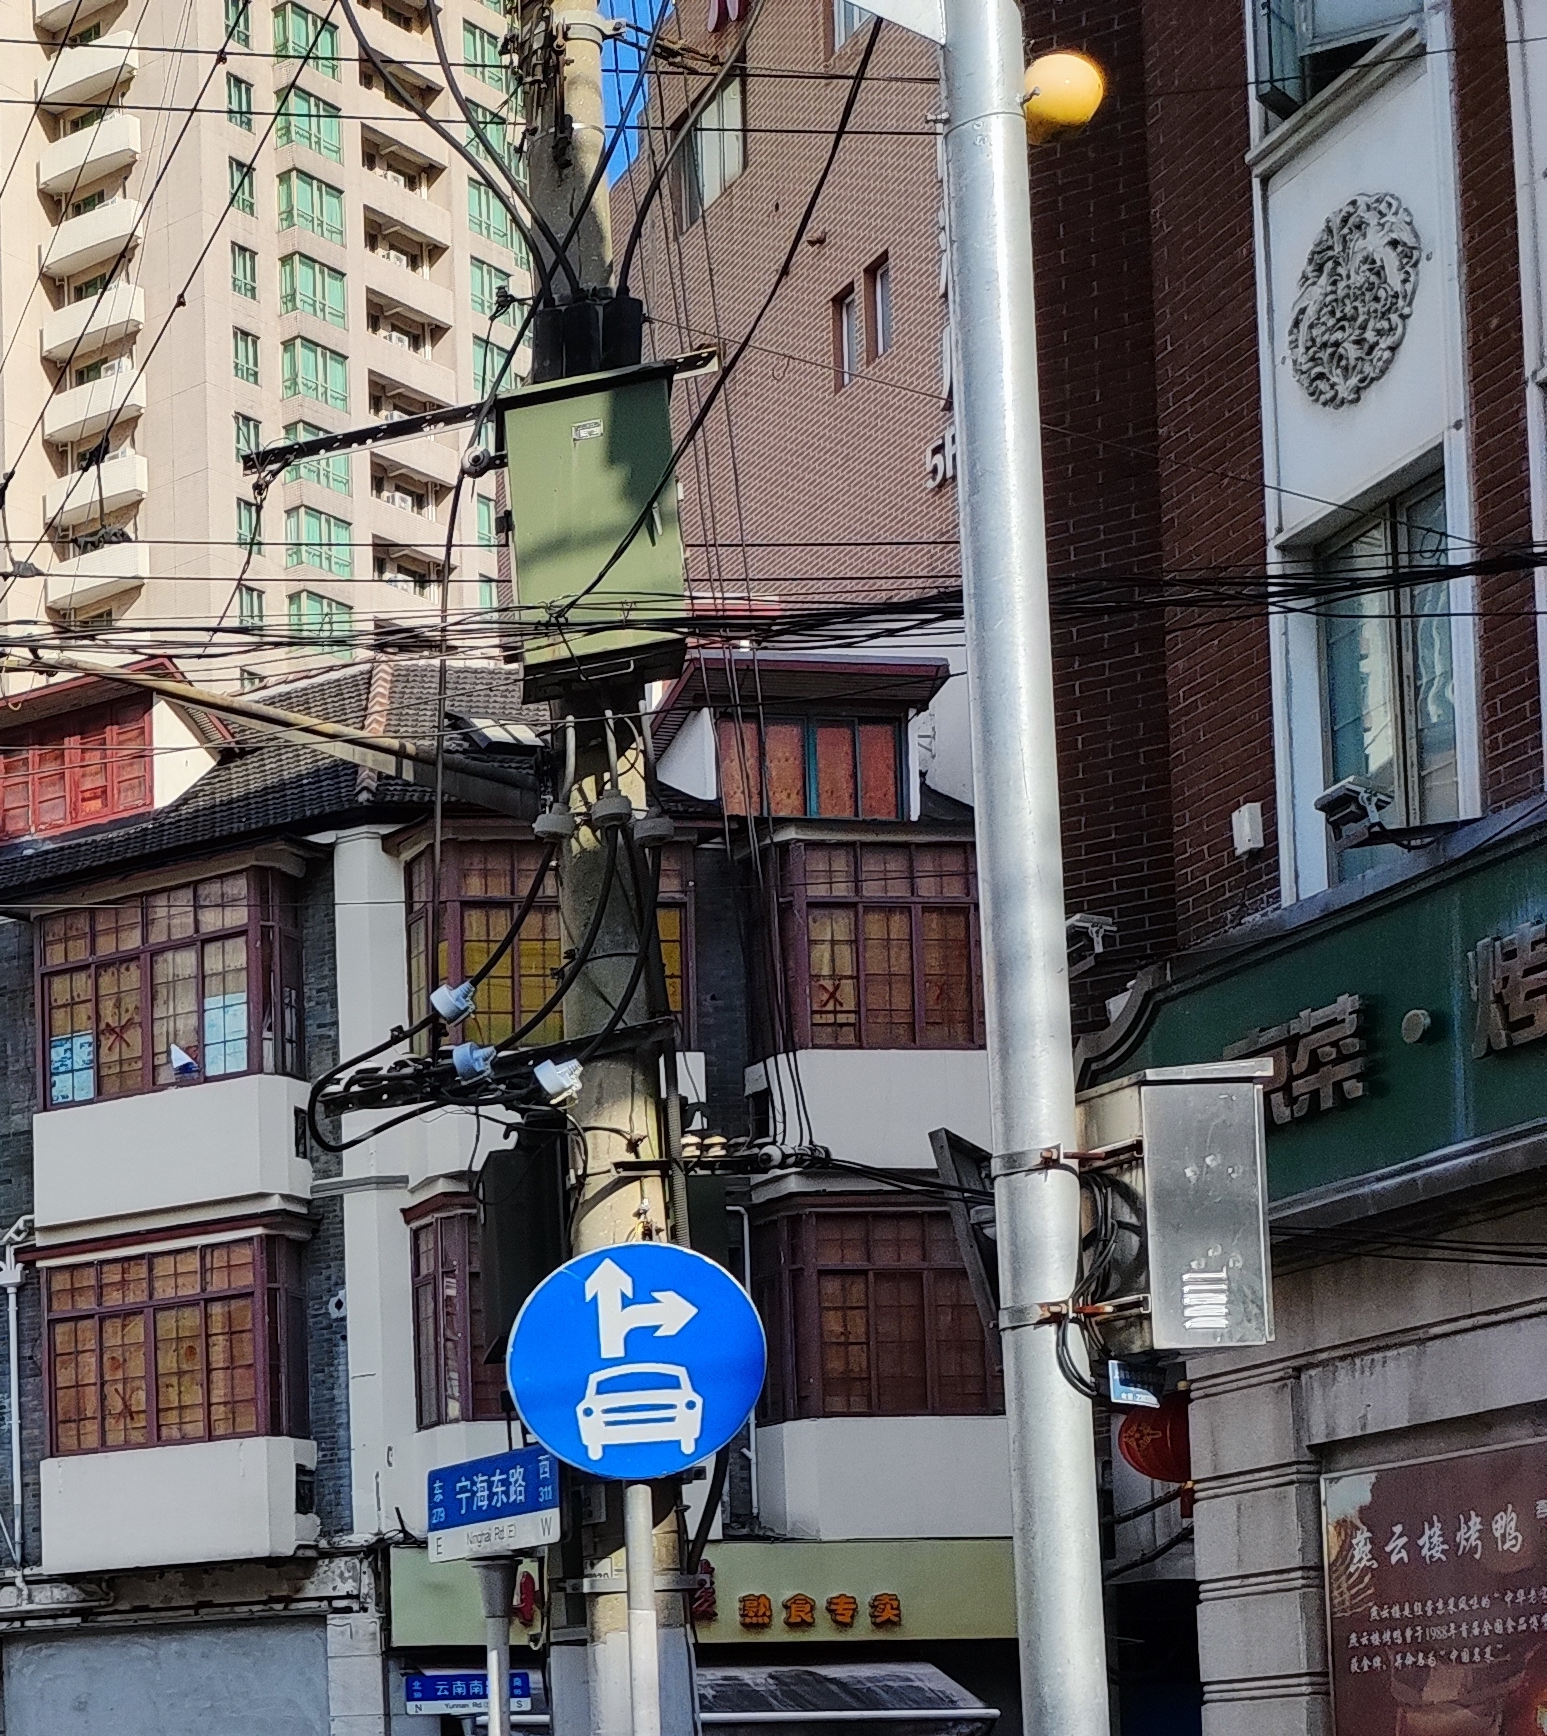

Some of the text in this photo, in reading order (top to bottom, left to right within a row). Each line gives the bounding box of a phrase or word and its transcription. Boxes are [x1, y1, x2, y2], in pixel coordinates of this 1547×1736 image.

[455, 1464, 527, 1516] 宁海东路
[540, 1516, 553, 1537] W
[436, 1536, 443, 1556] E
[1348, 1503, 1523, 1573] 燕云楼烤鸭
[738, 1593, 903, 1626] 熟食专卖
[435, 1680, 489, 1696] 云南南
[414, 1703, 423, 1713] N
[515, 1699, 523, 1709] S
